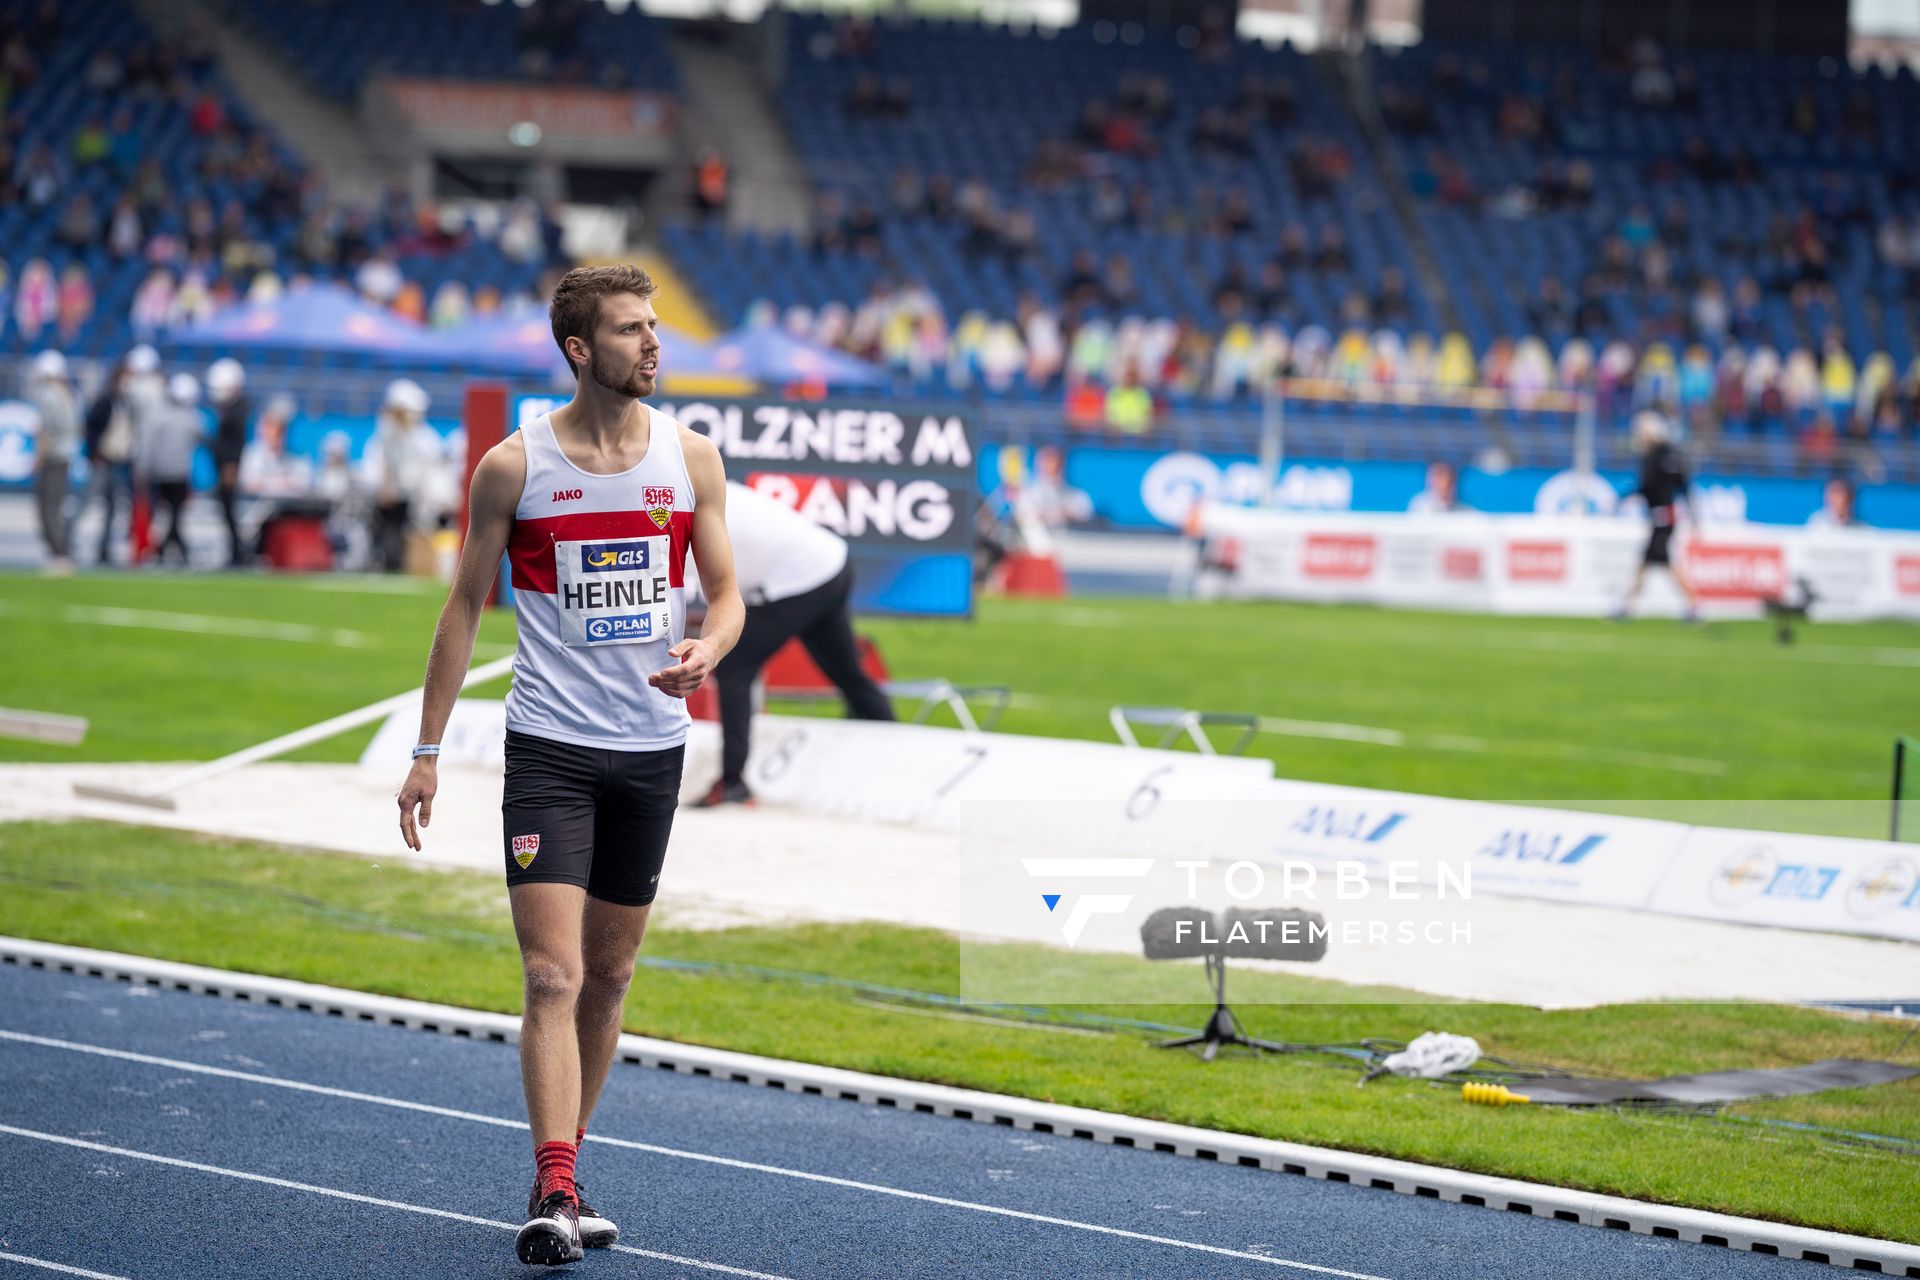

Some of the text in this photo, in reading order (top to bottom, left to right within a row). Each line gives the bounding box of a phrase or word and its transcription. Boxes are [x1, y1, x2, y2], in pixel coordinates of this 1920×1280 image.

[912, 415, 972, 468] M
[552, 489, 583, 502] JAKO
[617, 550, 644, 565] GLS
[563, 577, 667, 610] HEINLE
[614, 617, 649, 631] PLAN
[936, 744, 988, 800] 7
[1125, 765, 1173, 821] 6
